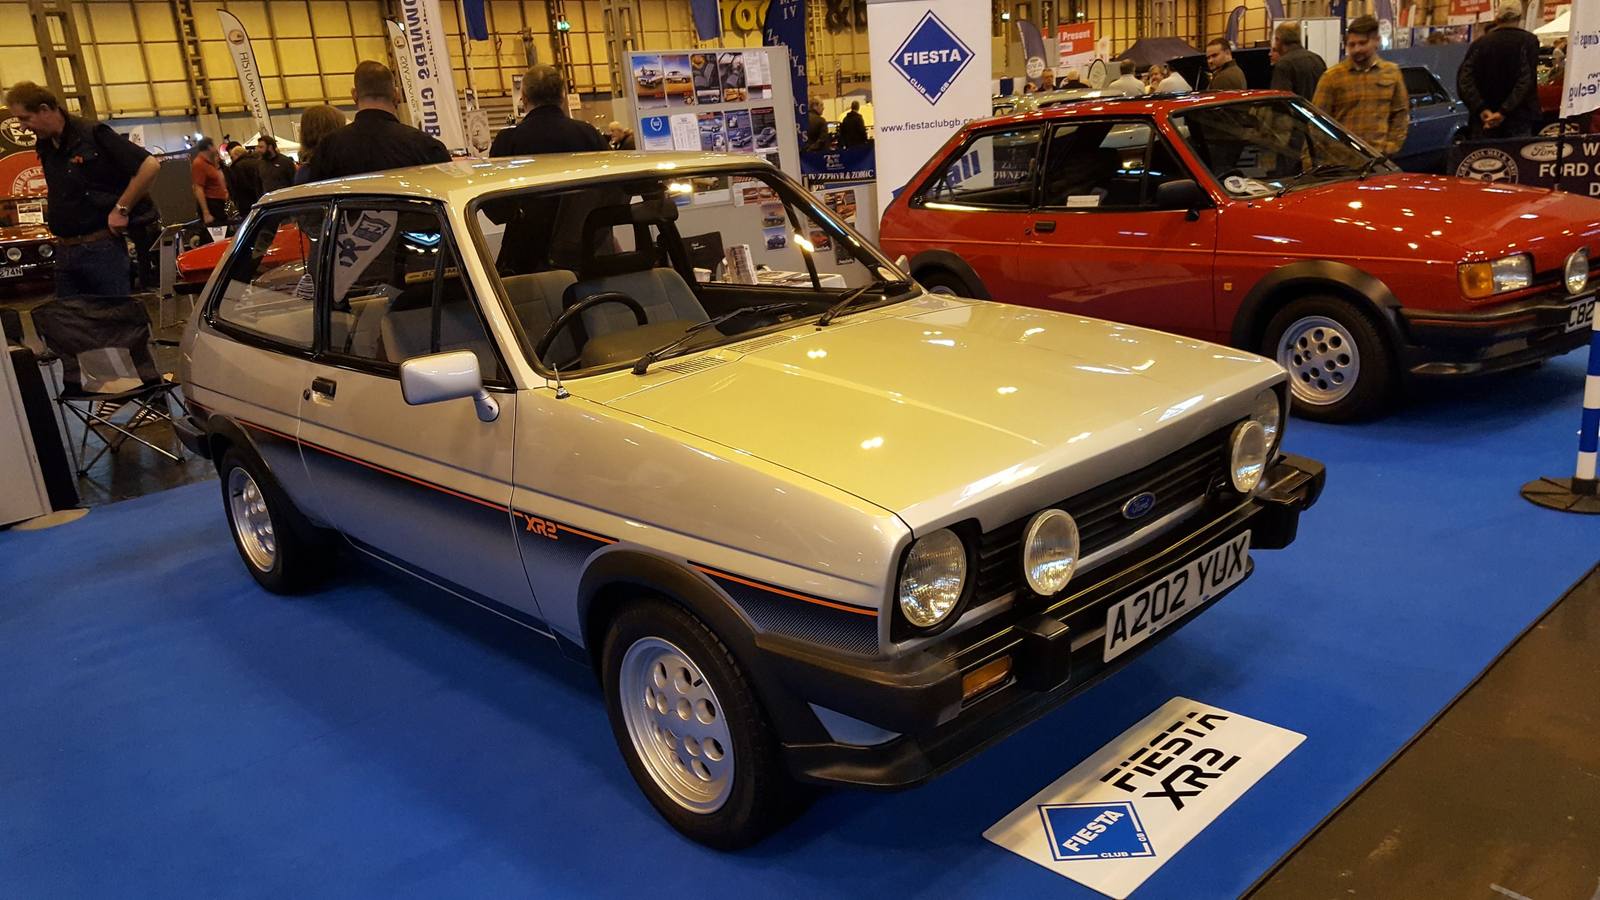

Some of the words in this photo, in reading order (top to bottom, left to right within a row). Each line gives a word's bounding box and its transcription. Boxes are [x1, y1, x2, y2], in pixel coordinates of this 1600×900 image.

[903, 48, 962, 66] FIESTA
[910, 78, 927, 95] CLUB
[881, 115, 985, 133] www.fiestaclubgb.co
[523, 514, 559, 540] XR2
[1109, 569, 1190, 650] A202
[1197, 535, 1248, 597] YUX
[1099, 711, 1230, 793] FIESTA
[1142, 747, 1242, 812] XR2
[1062, 808, 1125, 853] FIESTA
[1100, 851, 1129, 860] CLUB
